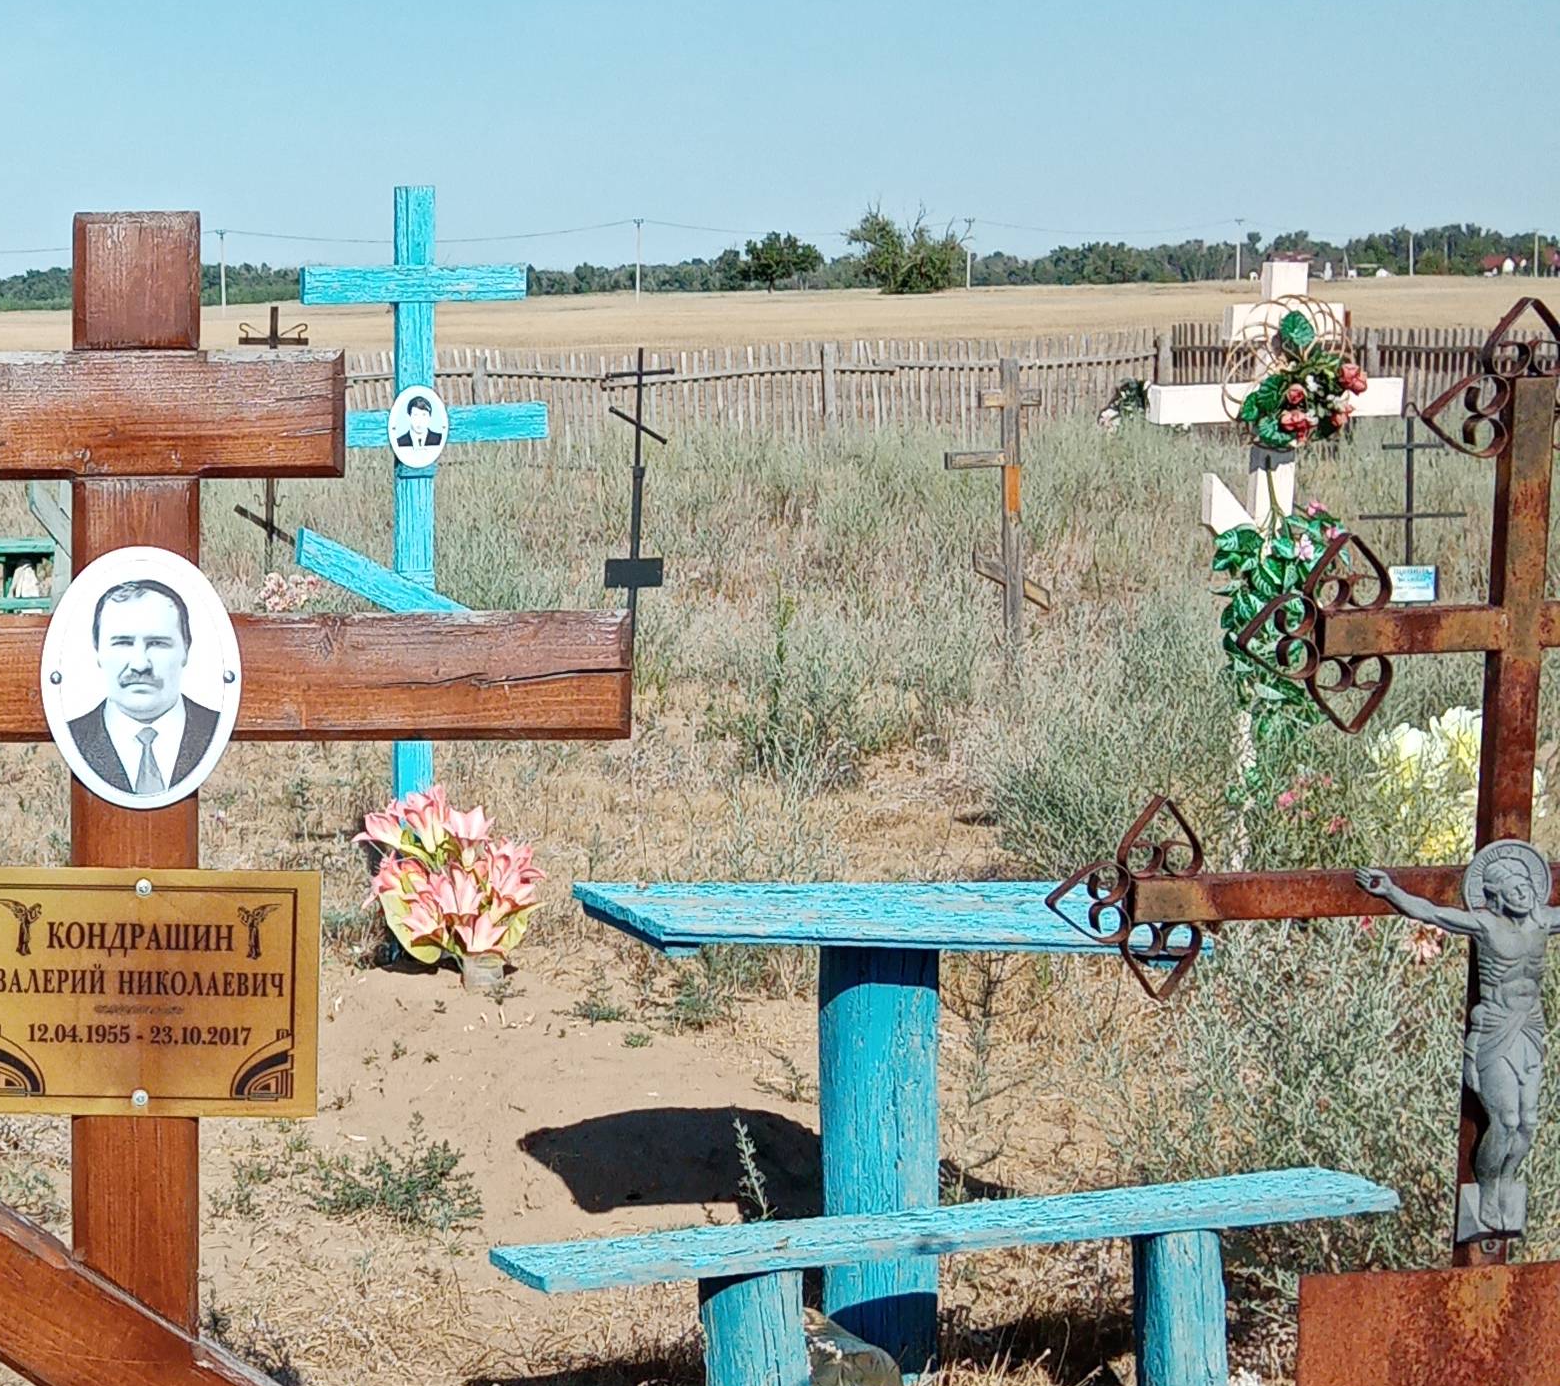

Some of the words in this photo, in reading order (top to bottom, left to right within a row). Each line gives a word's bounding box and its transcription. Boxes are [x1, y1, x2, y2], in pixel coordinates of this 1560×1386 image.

[46, 921, 234, 958] КОНДРАШИН
[118, 969, 285, 998] НИКОЛАЕВИЧ
[28, 1023, 131, 1044] 12.04.1955
[149, 1025, 252, 1047] 23.10.2017
